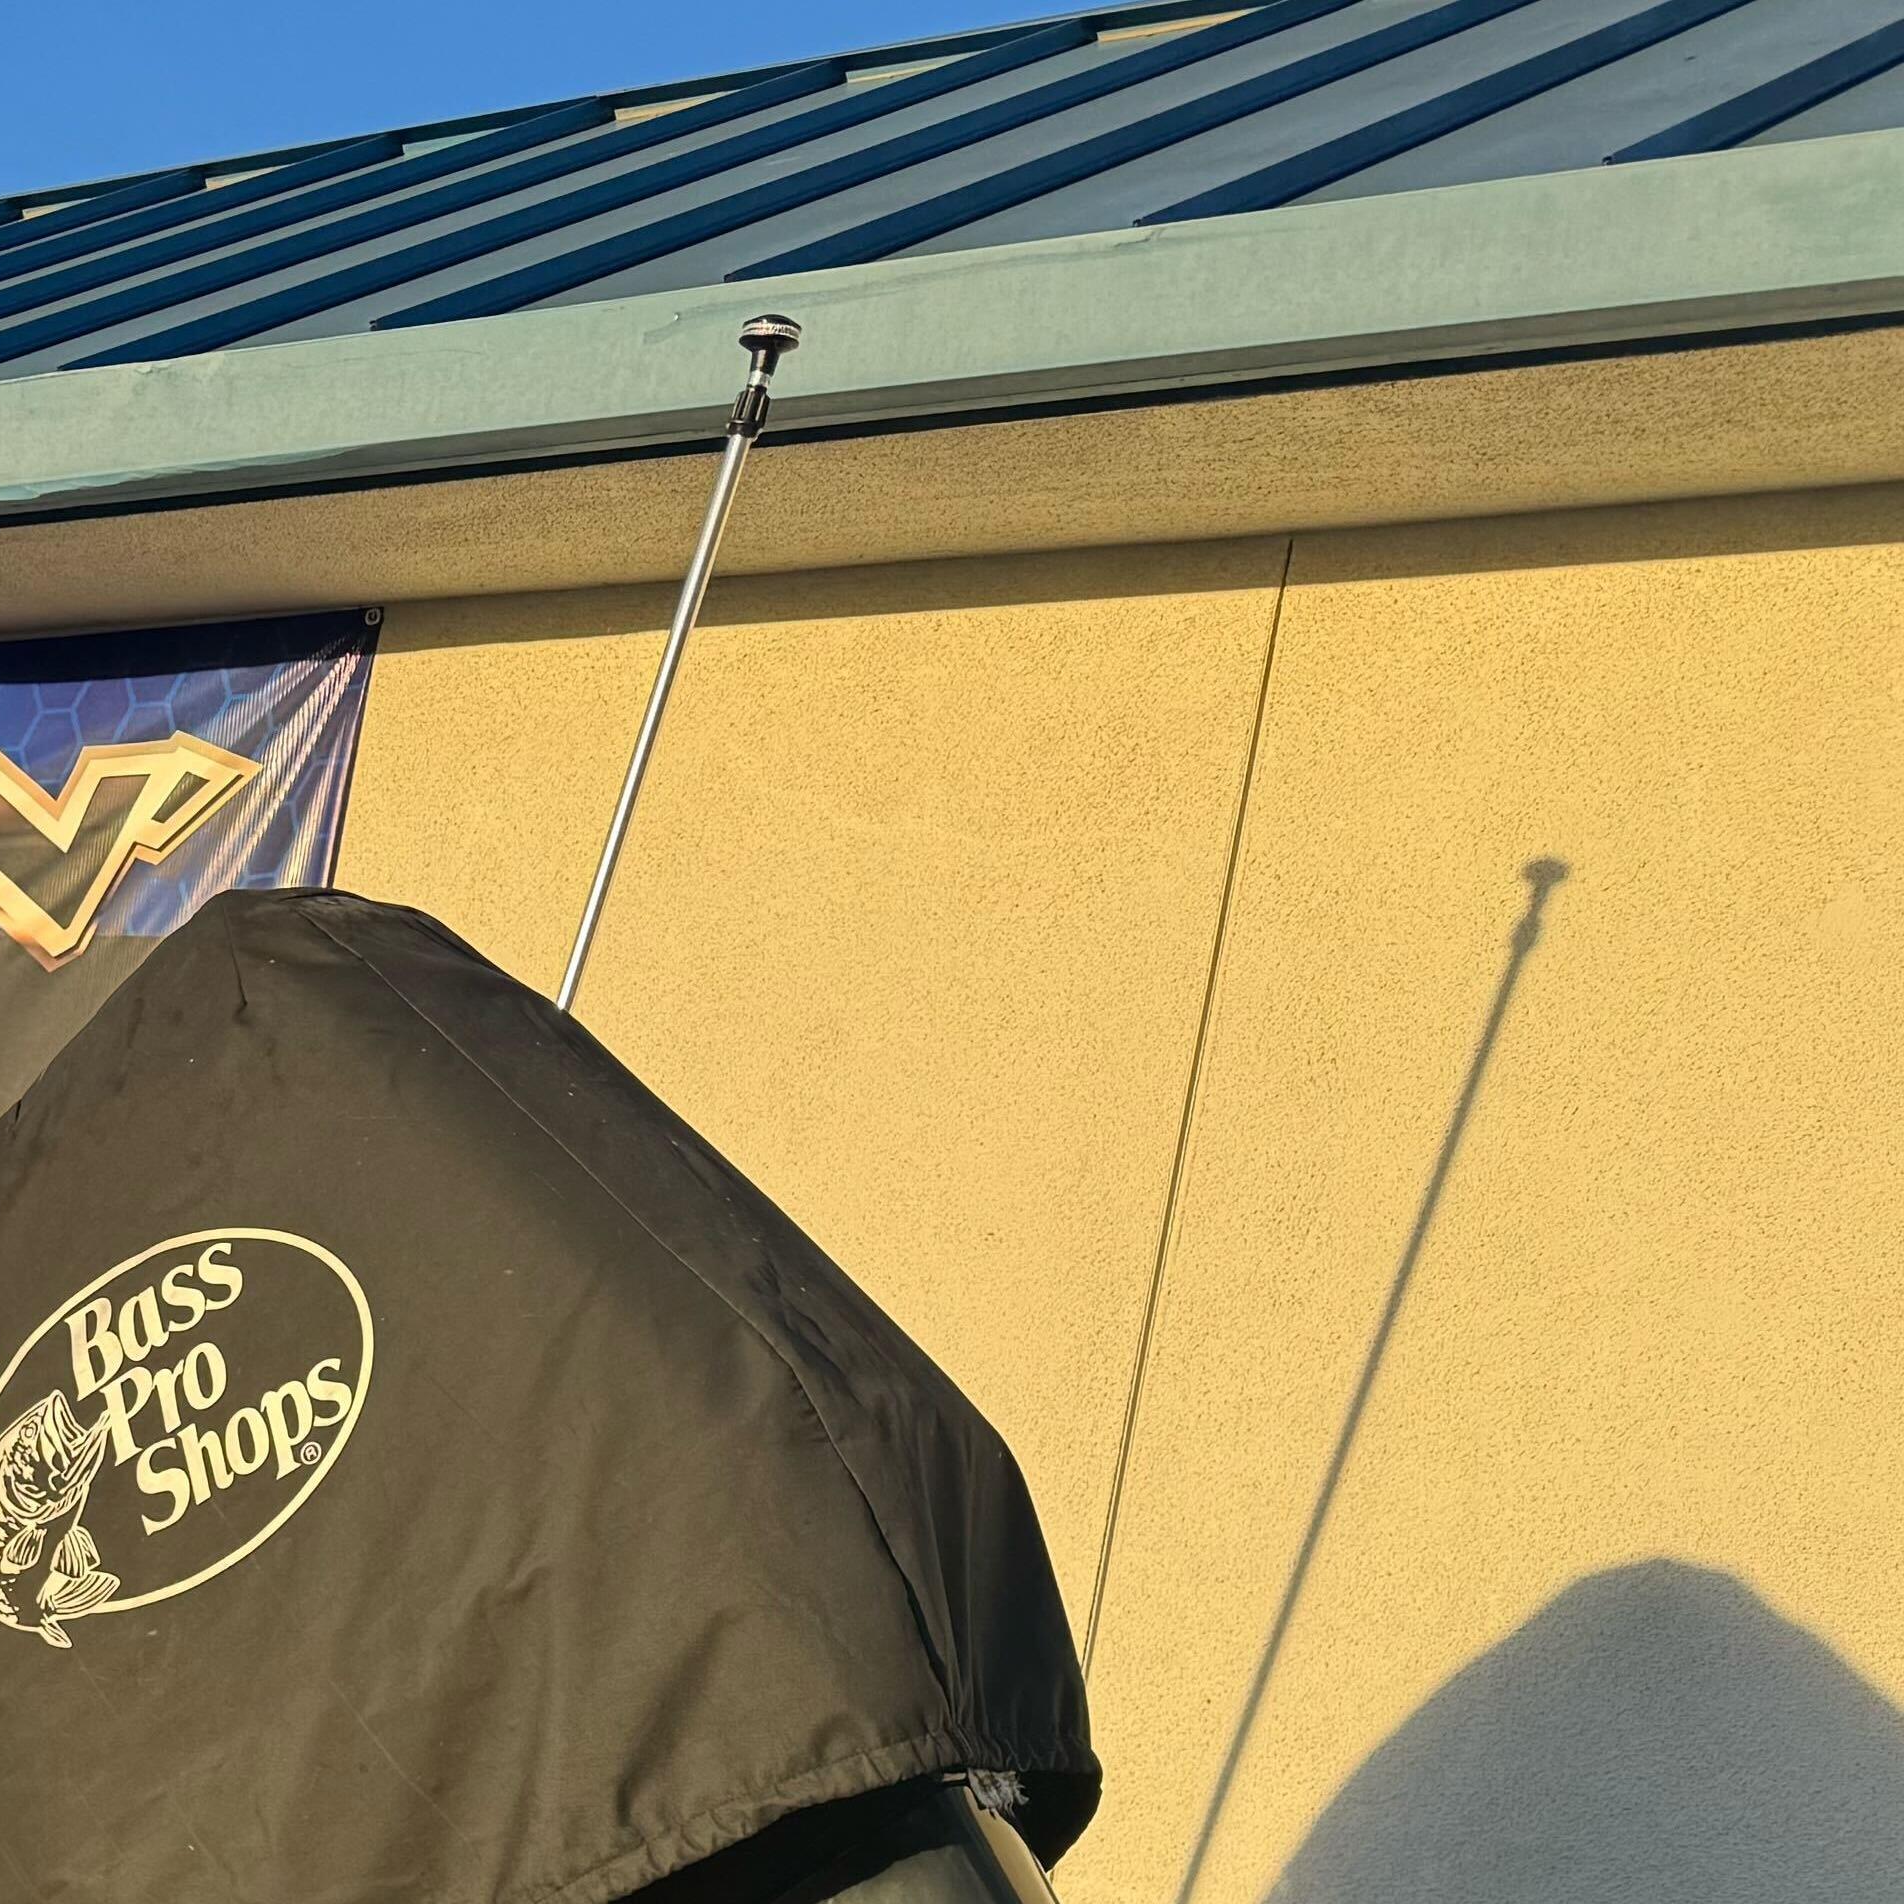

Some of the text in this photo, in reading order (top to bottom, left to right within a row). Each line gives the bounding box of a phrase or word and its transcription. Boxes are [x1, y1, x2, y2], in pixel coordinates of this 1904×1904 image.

[63, 1241, 244, 1402] Bass
[99, 1341, 228, 1467] Pro
[135, 1357, 353, 1537] Shops
